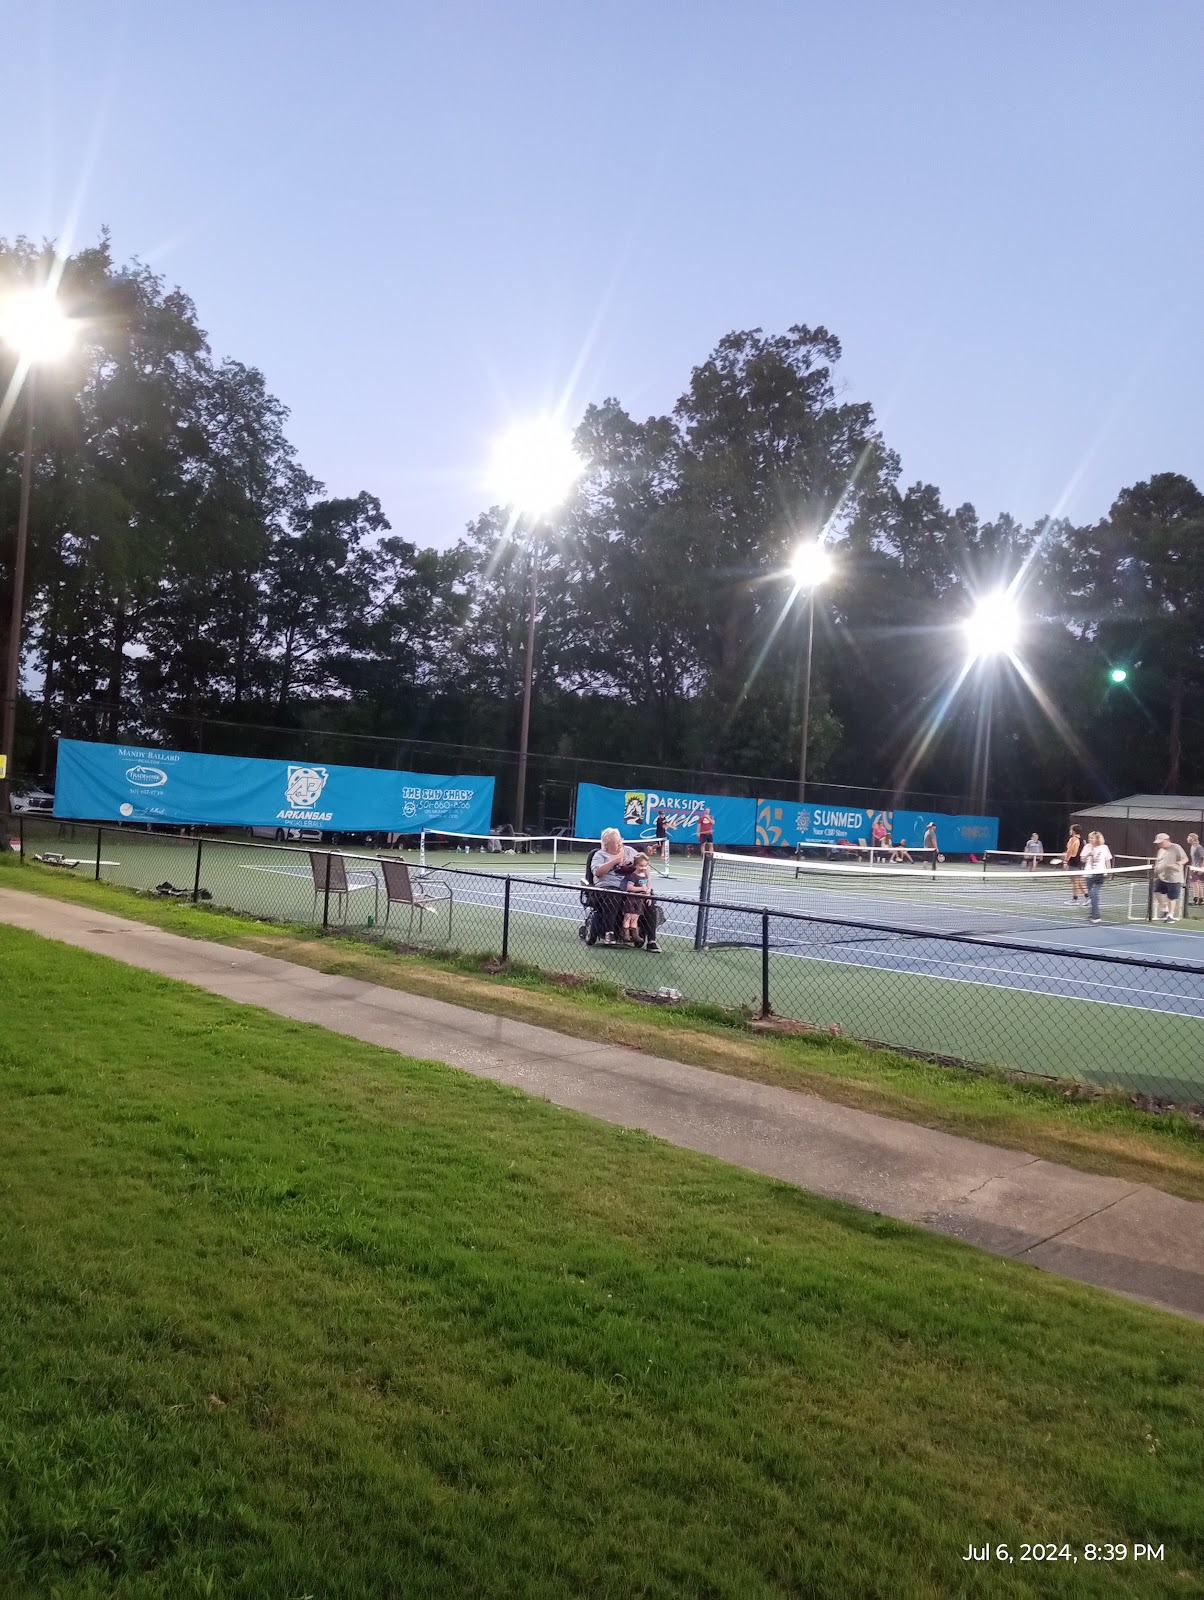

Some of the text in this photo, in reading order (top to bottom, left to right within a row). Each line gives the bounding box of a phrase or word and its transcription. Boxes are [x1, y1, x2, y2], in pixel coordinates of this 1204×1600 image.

[118, 748, 180, 762] MANDY BALLARD
[402, 787, 474, 801] THE SUN SHACK
[276, 810, 333, 821] ARKANSAS
[645, 793, 706, 826] PARKSIDE
[284, 819, 325, 828] PICKLEBALL
[813, 809, 862, 829] SUNMED
[813, 827, 848, 837] Your CBD Store
